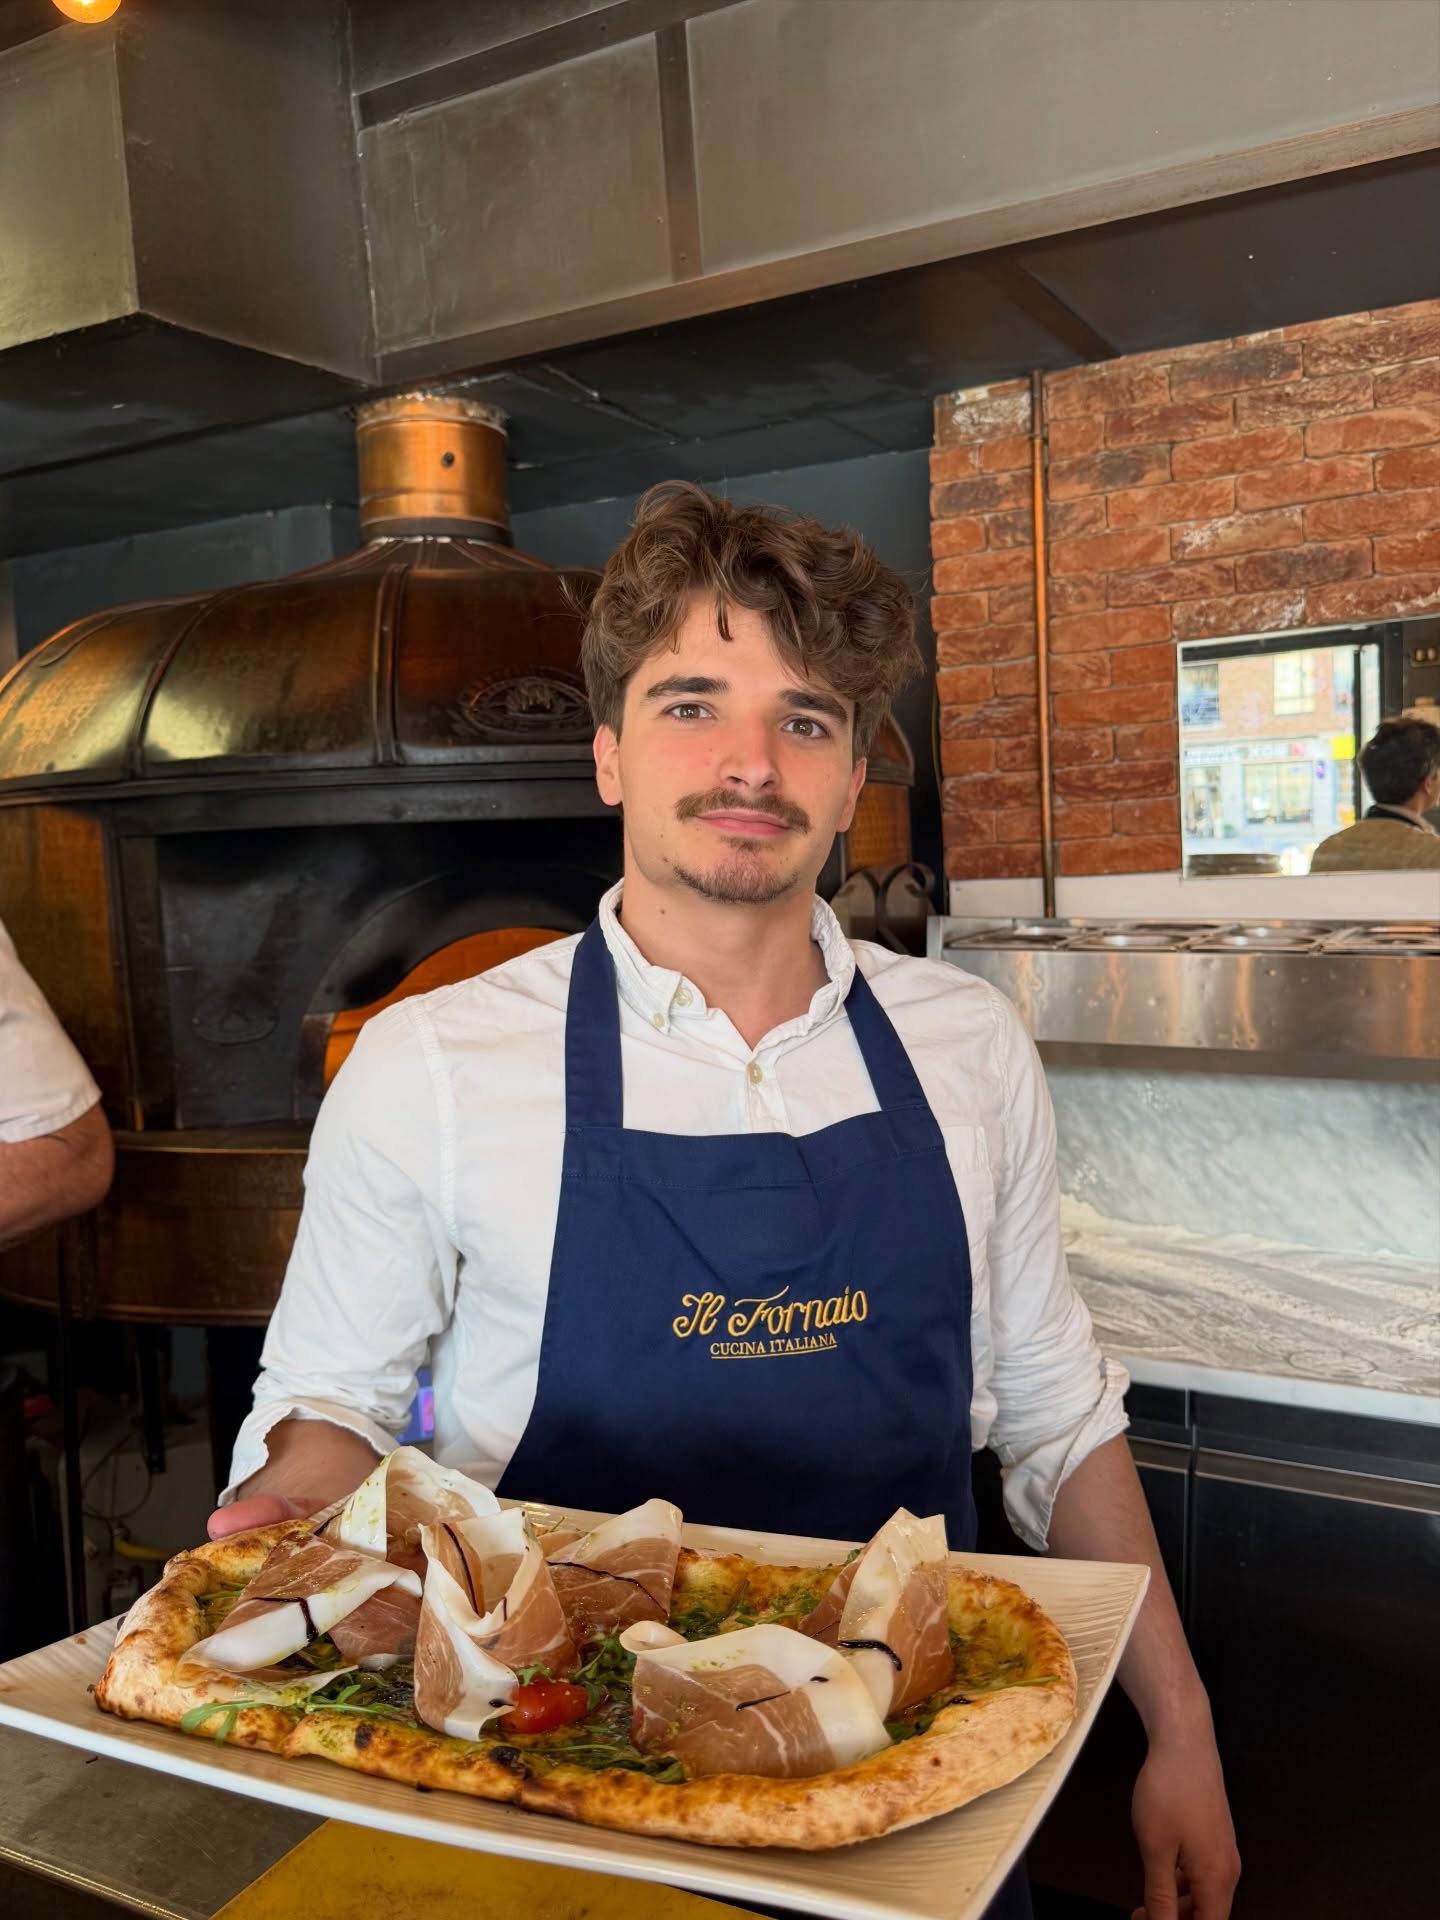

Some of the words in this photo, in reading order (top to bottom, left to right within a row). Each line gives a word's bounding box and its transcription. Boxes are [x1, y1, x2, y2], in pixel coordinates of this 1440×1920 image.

[672, 1292, 725, 1337] Il
[728, 1285, 868, 1337] Fornaio
[709, 1342, 766, 1356] CUCINA
[770, 1332, 837, 1353] ITALIANA
